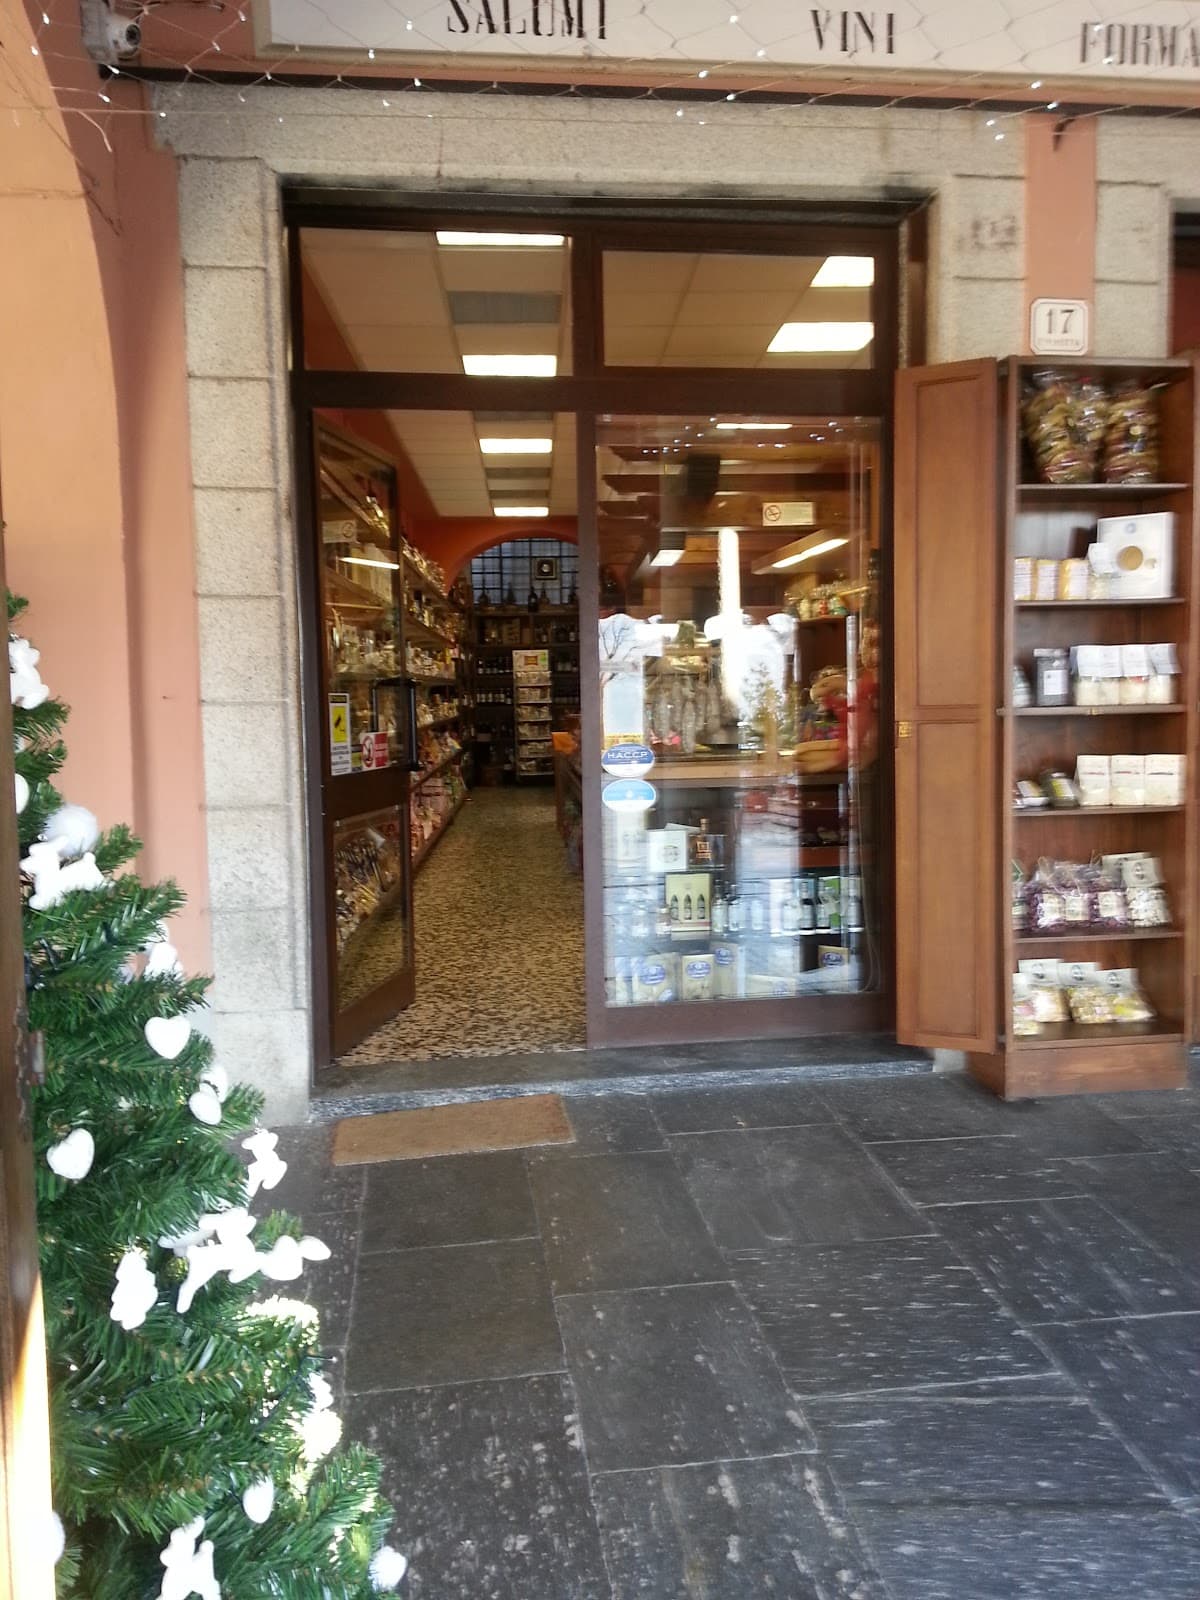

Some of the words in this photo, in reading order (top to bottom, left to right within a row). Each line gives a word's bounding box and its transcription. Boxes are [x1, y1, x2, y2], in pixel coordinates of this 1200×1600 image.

[447, 0, 606, 39] SALUMI
[810, 9, 895, 54] VINI
[1046, 308, 1075, 335] 17
